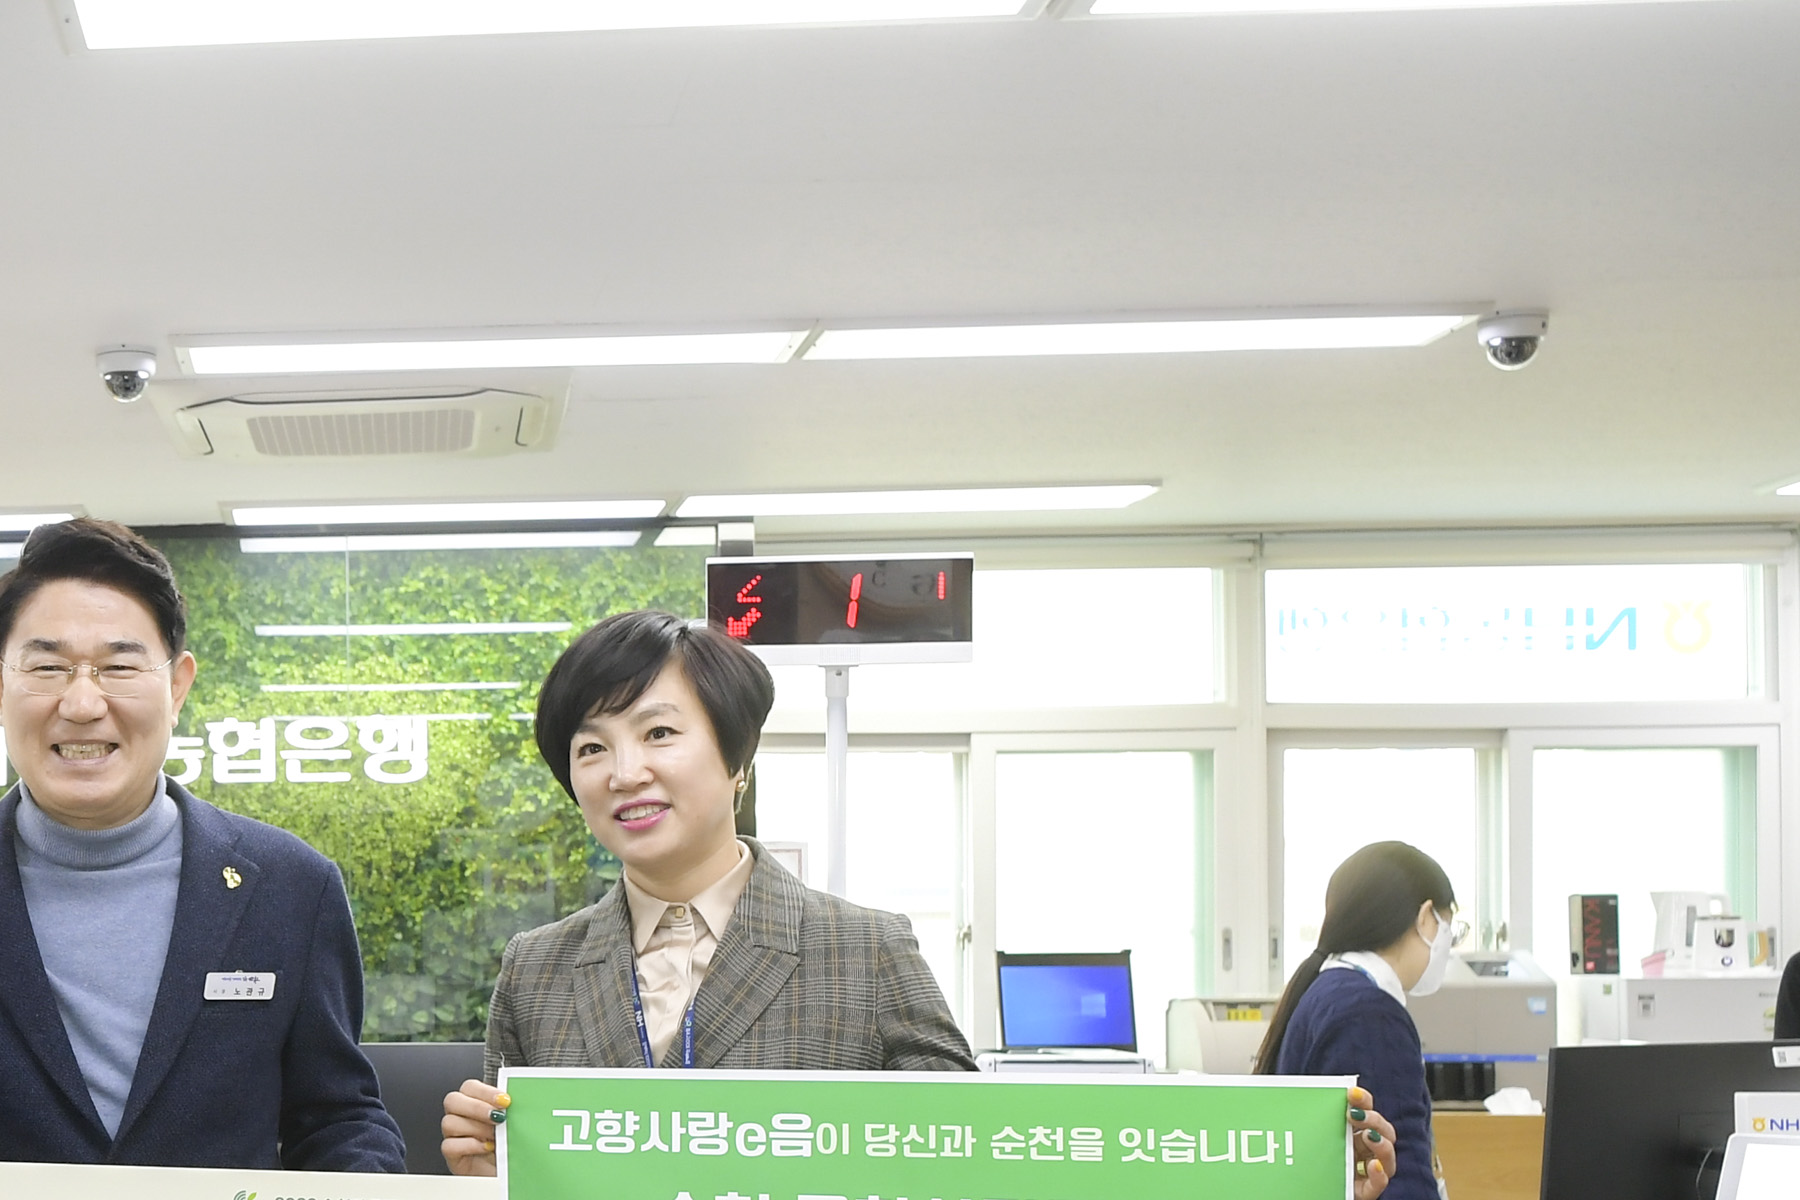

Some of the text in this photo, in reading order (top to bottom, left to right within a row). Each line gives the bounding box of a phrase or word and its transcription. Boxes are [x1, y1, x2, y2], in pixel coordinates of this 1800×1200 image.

[549, 1107, 1295, 1167] 고향사랑e음이 당신과 순천을 잇습니다!
[1770, 1118, 1800, 1131] NH
